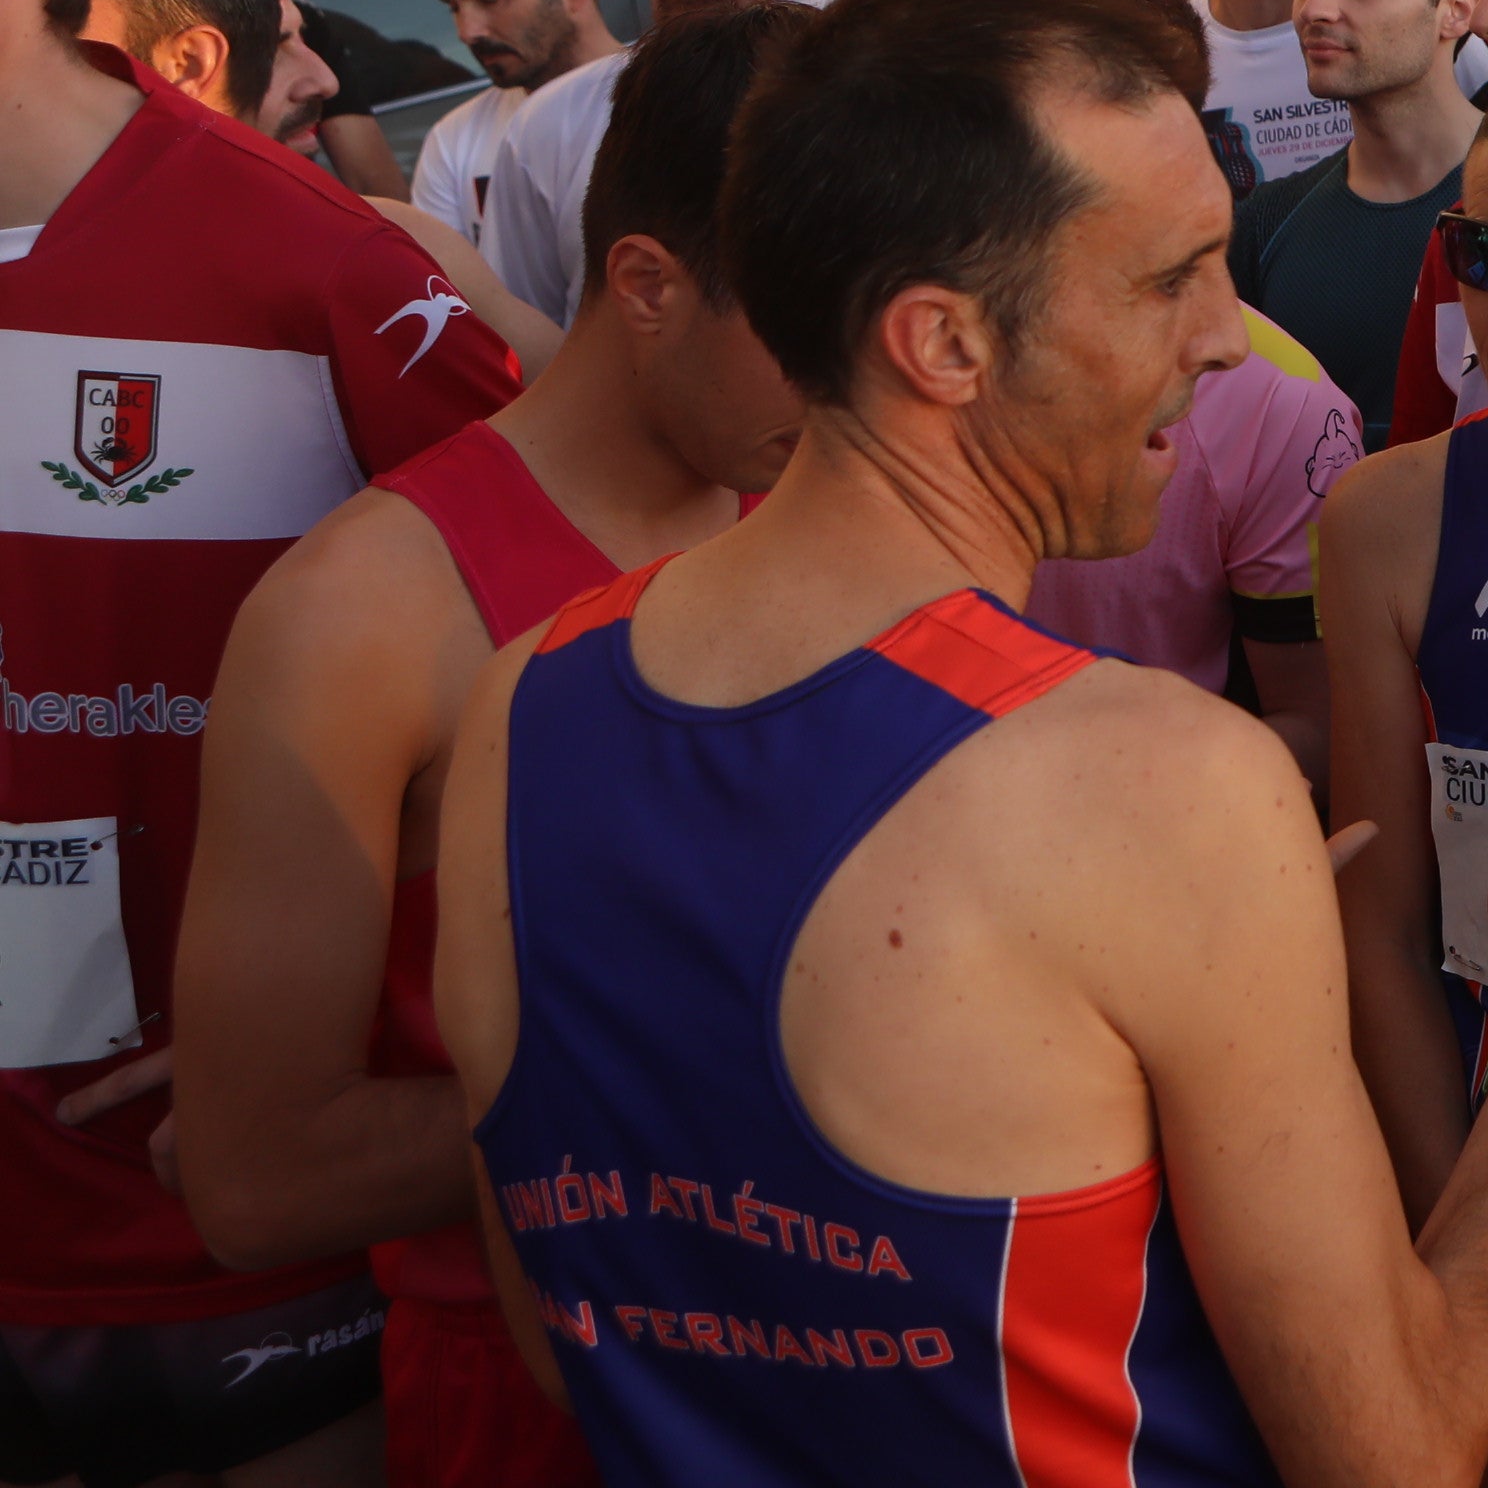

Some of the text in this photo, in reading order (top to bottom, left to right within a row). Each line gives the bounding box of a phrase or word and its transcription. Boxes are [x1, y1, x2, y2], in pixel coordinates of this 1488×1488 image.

[1253, 100, 1349, 123] SAN SILVESTR
[1256, 116, 1353, 144] CIUDAD DE CÁDI
[1258, 145, 1288, 157] JUEVES
[1302, 141, 1313, 151] DE
[88, 388, 145, 408] CABC
[0, 855, 90, 886] ÁDIZ
[502, 1153, 912, 1281] UNIÓN ATLÉTICA
[307, 1307, 385, 1358] rasán
[614, 1305, 955, 1369] FERNANDO
